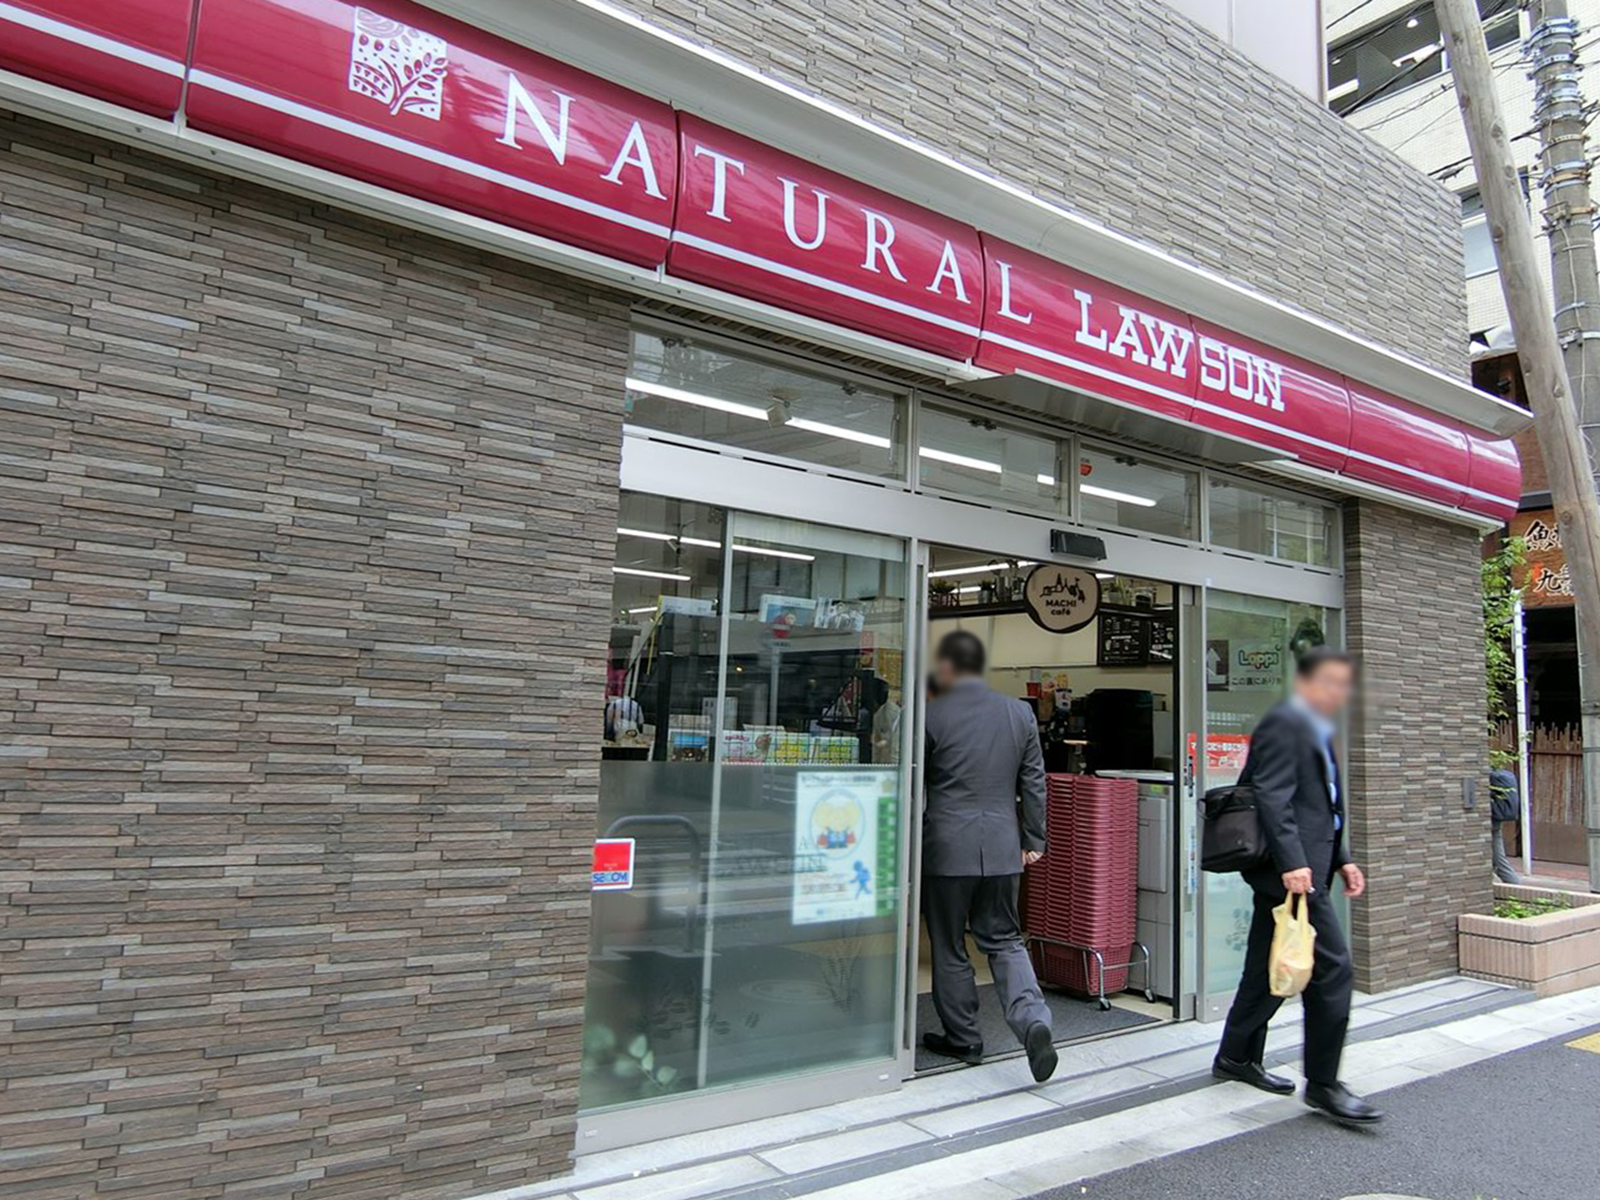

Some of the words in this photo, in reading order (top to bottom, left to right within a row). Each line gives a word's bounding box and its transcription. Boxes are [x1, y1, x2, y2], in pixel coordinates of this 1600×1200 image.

[495, 72, 1033, 325] NATURAL
[1073, 288, 1286, 412] LAWSON
[1524, 519, 1562, 552] 魚
[1045, 599, 1077, 608] MACHI
[592, 871, 629, 883] SECOM
